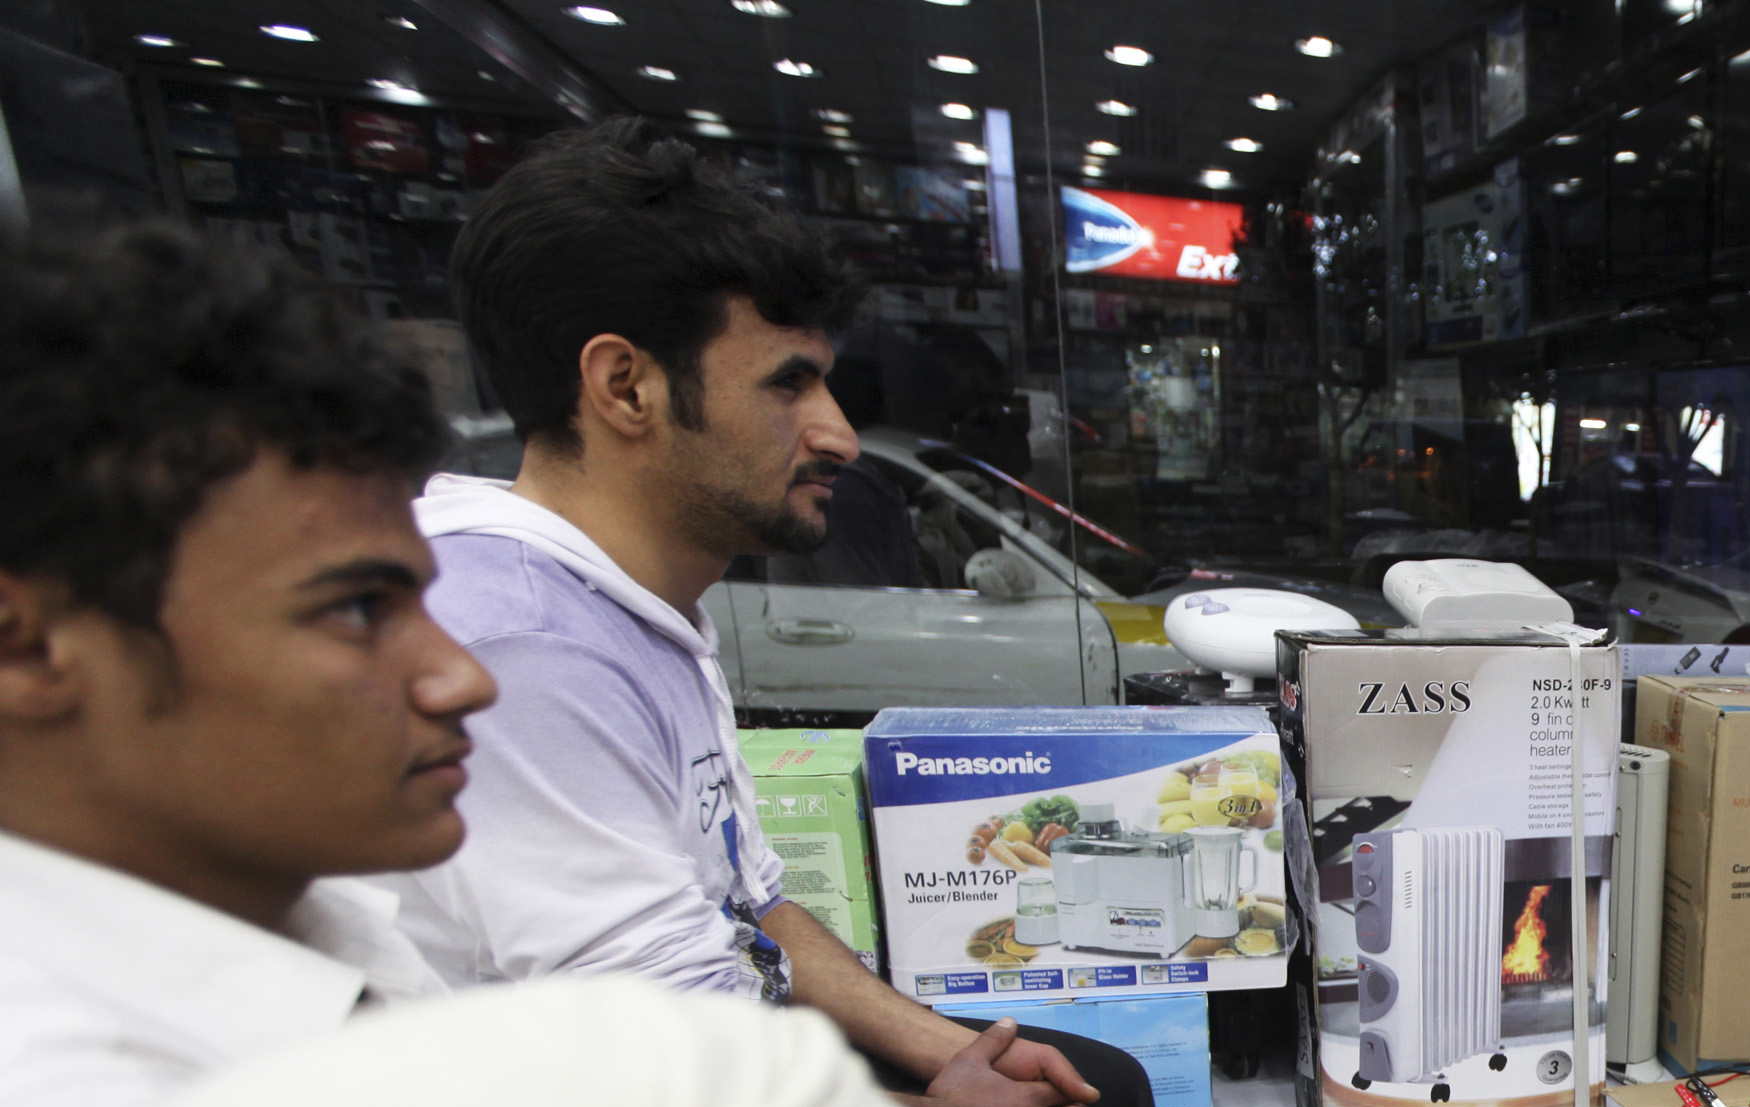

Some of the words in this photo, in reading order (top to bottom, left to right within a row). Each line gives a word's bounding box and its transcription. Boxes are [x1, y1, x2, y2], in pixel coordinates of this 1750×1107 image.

[1532, 679, 1612, 692] NSD-20F-9
[1356, 681, 1472, 715] ZASS
[1530, 696, 1551, 709] 2.0
[1554, 696, 1590, 709] Kwtt
[1531, 712, 1540, 725] 9
[1547, 712, 1562, 725] fin
[1529, 744, 1572, 757] heater
[895, 751, 1052, 776] Panasonic
[1223, 799, 1234, 814] 3
[1235, 802, 1247, 813] in
[1250, 801, 1258, 813] 1
[904, 869, 1018, 888] MJ-M176P
[908, 890, 999, 905] Juicer/Blender
[1549, 1060, 1559, 1075] 3
